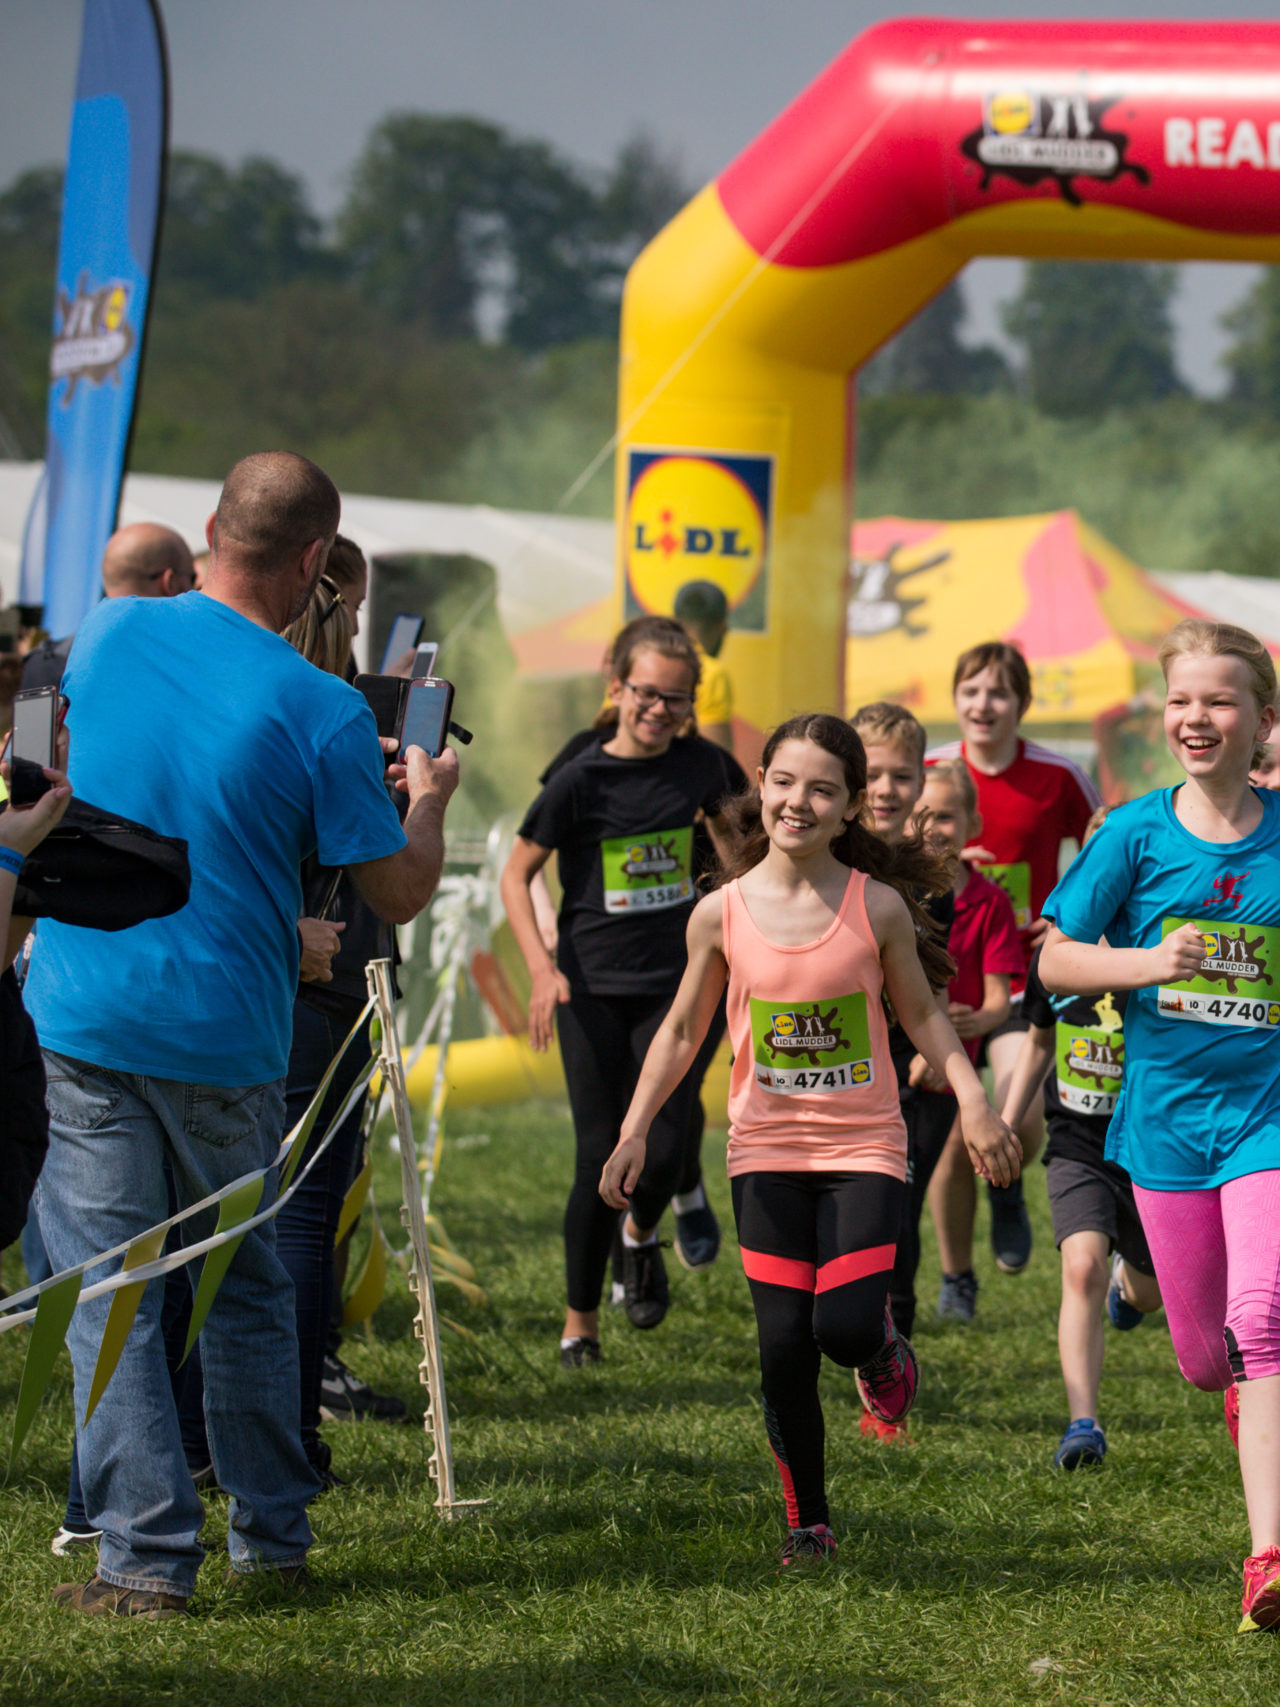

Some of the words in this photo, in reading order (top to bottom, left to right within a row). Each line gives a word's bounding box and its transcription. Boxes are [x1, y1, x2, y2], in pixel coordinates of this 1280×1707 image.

[1202, 960, 1213, 968] DL
[1216, 961, 1255, 973] MUDDER
[1207, 999, 1265, 1021] 4740
[775, 1038, 794, 1046] LIDL
[796, 1036, 833, 1046] MUDDER
[794, 1068, 847, 1089] 4741
[1081, 1093, 1114, 1110] 471
